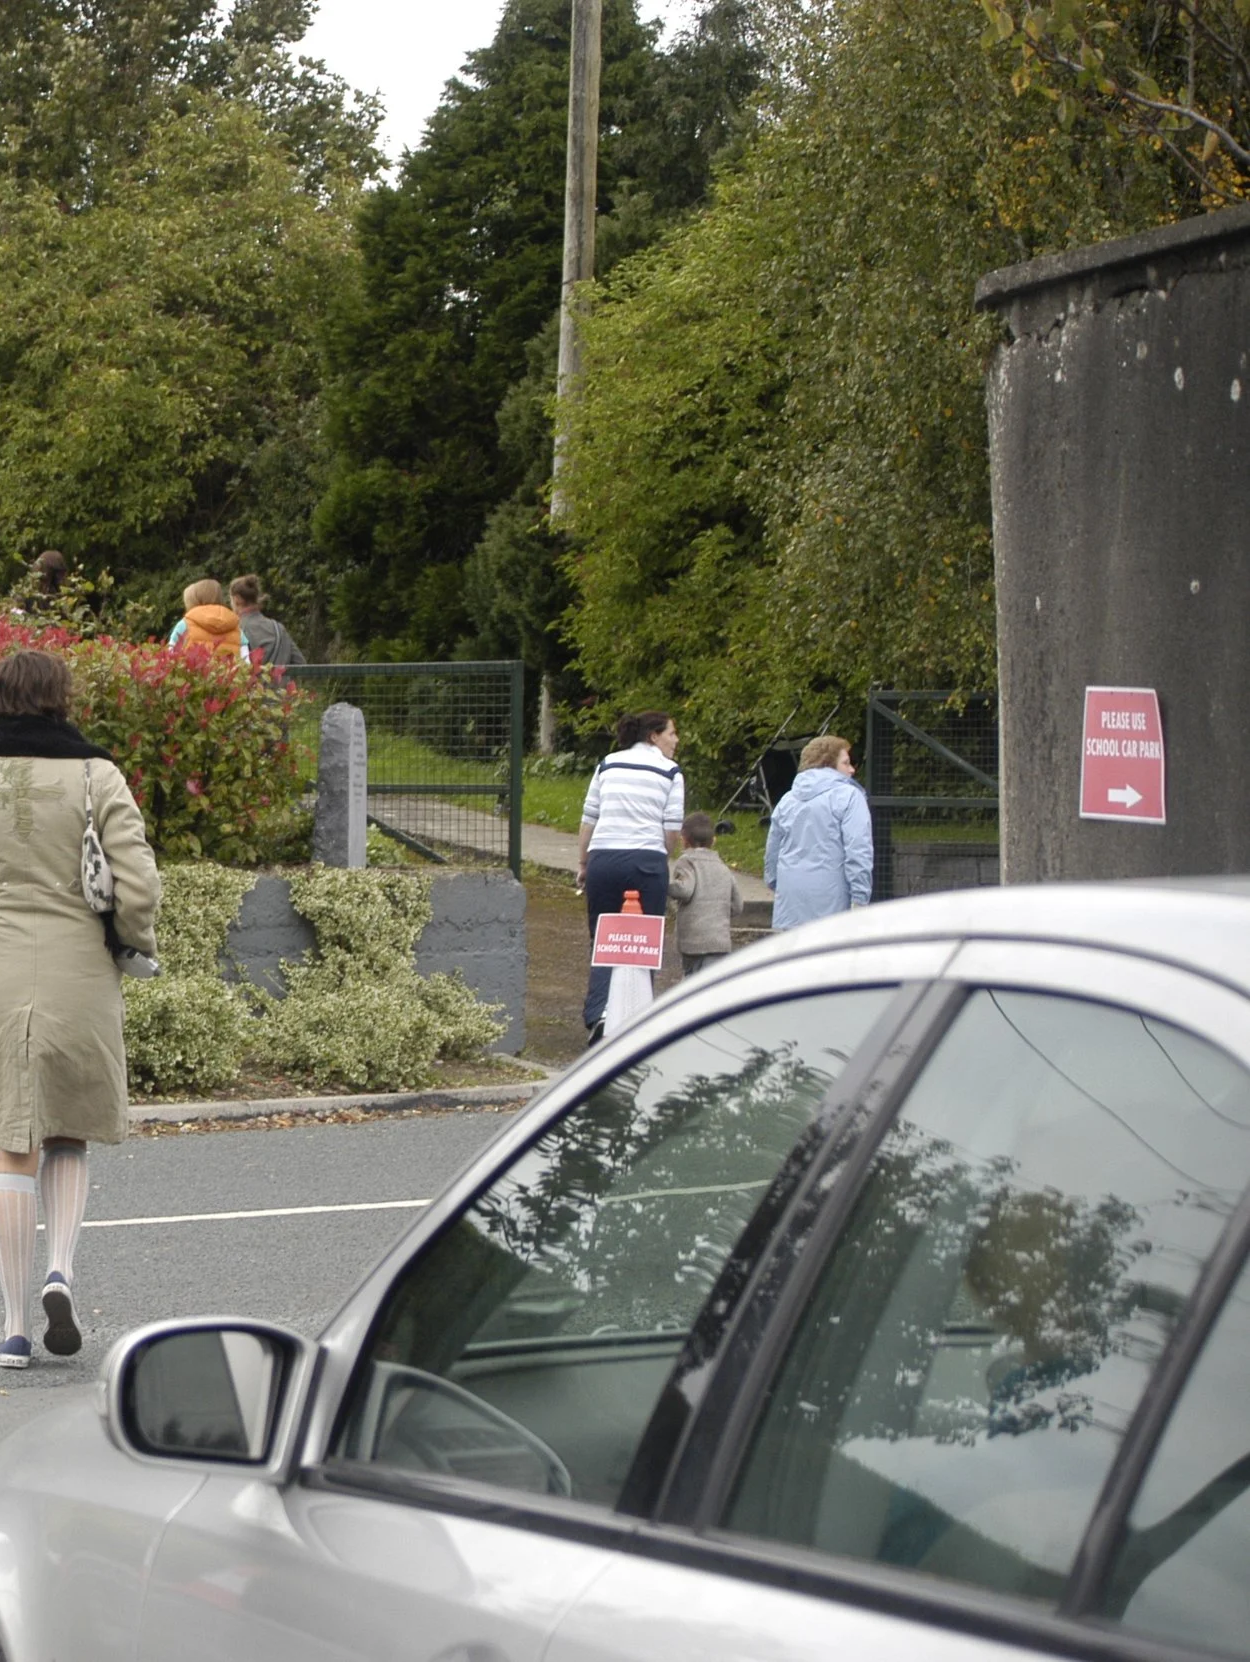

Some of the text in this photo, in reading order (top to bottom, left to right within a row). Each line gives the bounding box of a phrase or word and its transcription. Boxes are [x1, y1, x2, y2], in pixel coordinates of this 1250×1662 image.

[1101, 711, 1146, 730] PLEASE USE
[1086, 737, 1161, 759] SCHOOL CAR PARK
[608, 933, 647, 943] PLEASE USE
[596, 944, 659, 955] SCHOOL CAR PARK
